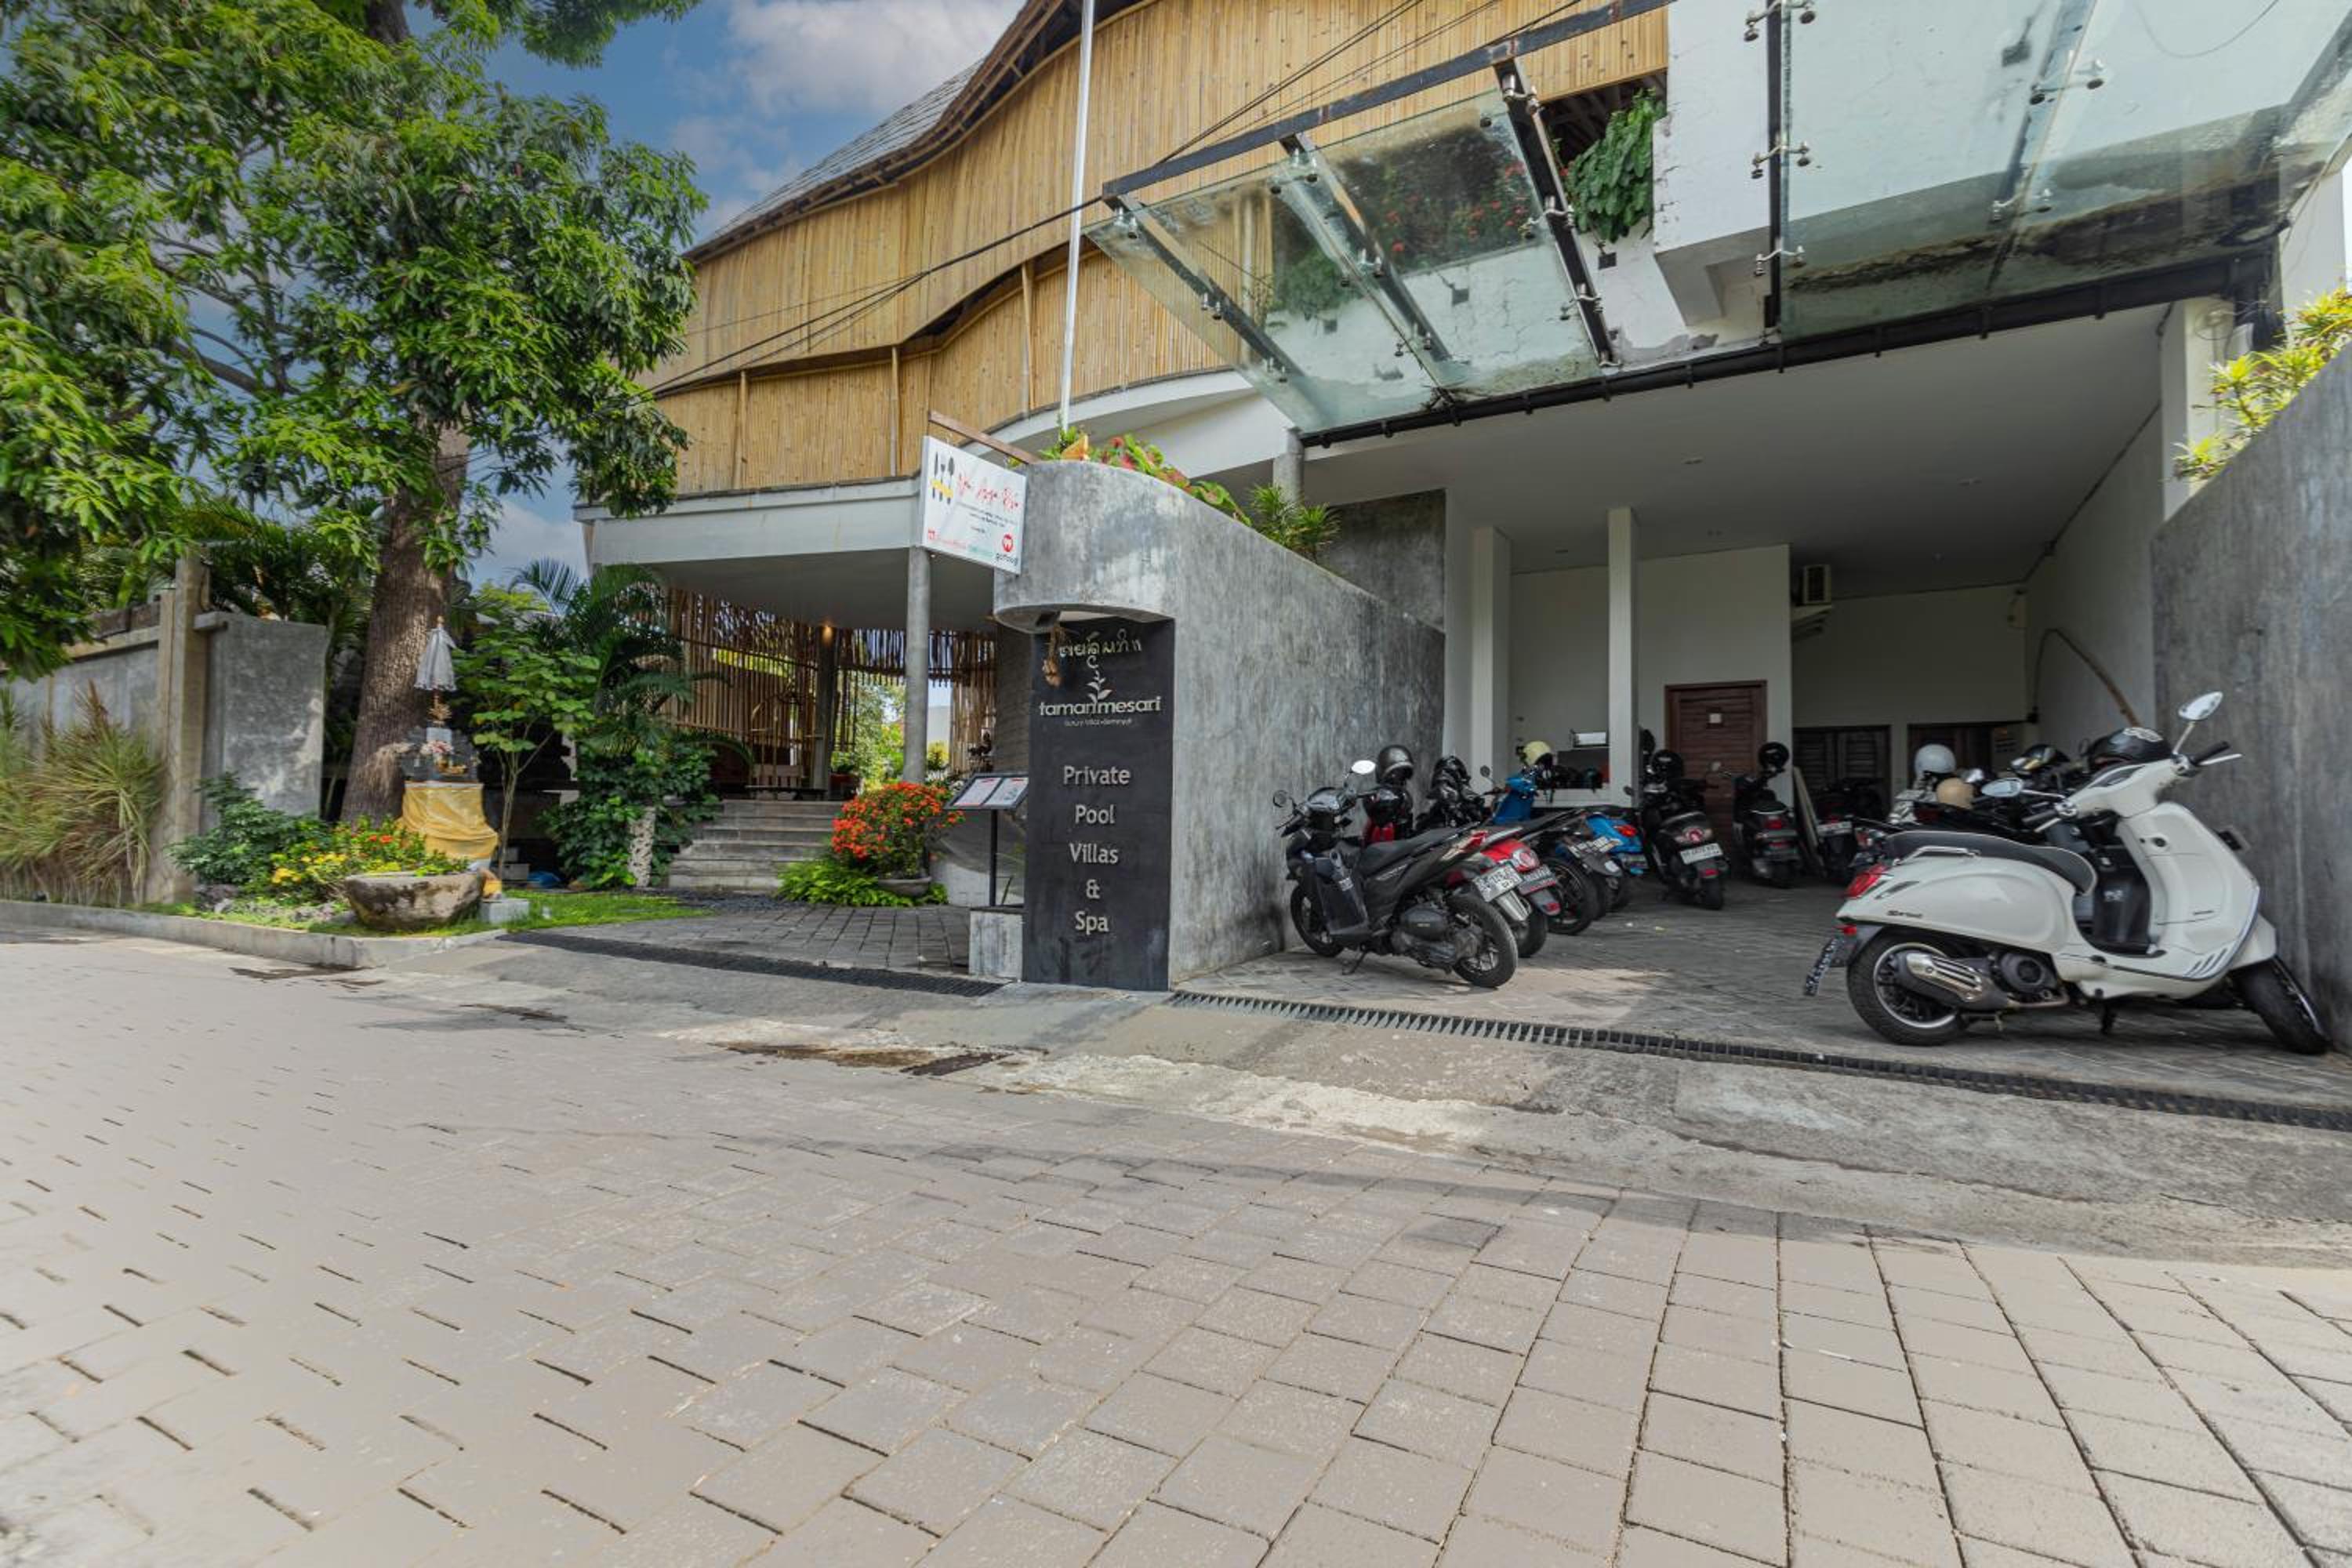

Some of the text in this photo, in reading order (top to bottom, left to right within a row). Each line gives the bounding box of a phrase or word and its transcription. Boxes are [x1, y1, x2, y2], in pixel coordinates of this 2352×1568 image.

[1063, 765, 1131, 786] Private
[1075, 804, 1116, 825] Pool
[1069, 842, 1119, 864] Villas
[1086, 879, 1101, 899] &
[1075, 911, 1109, 935] Spa
